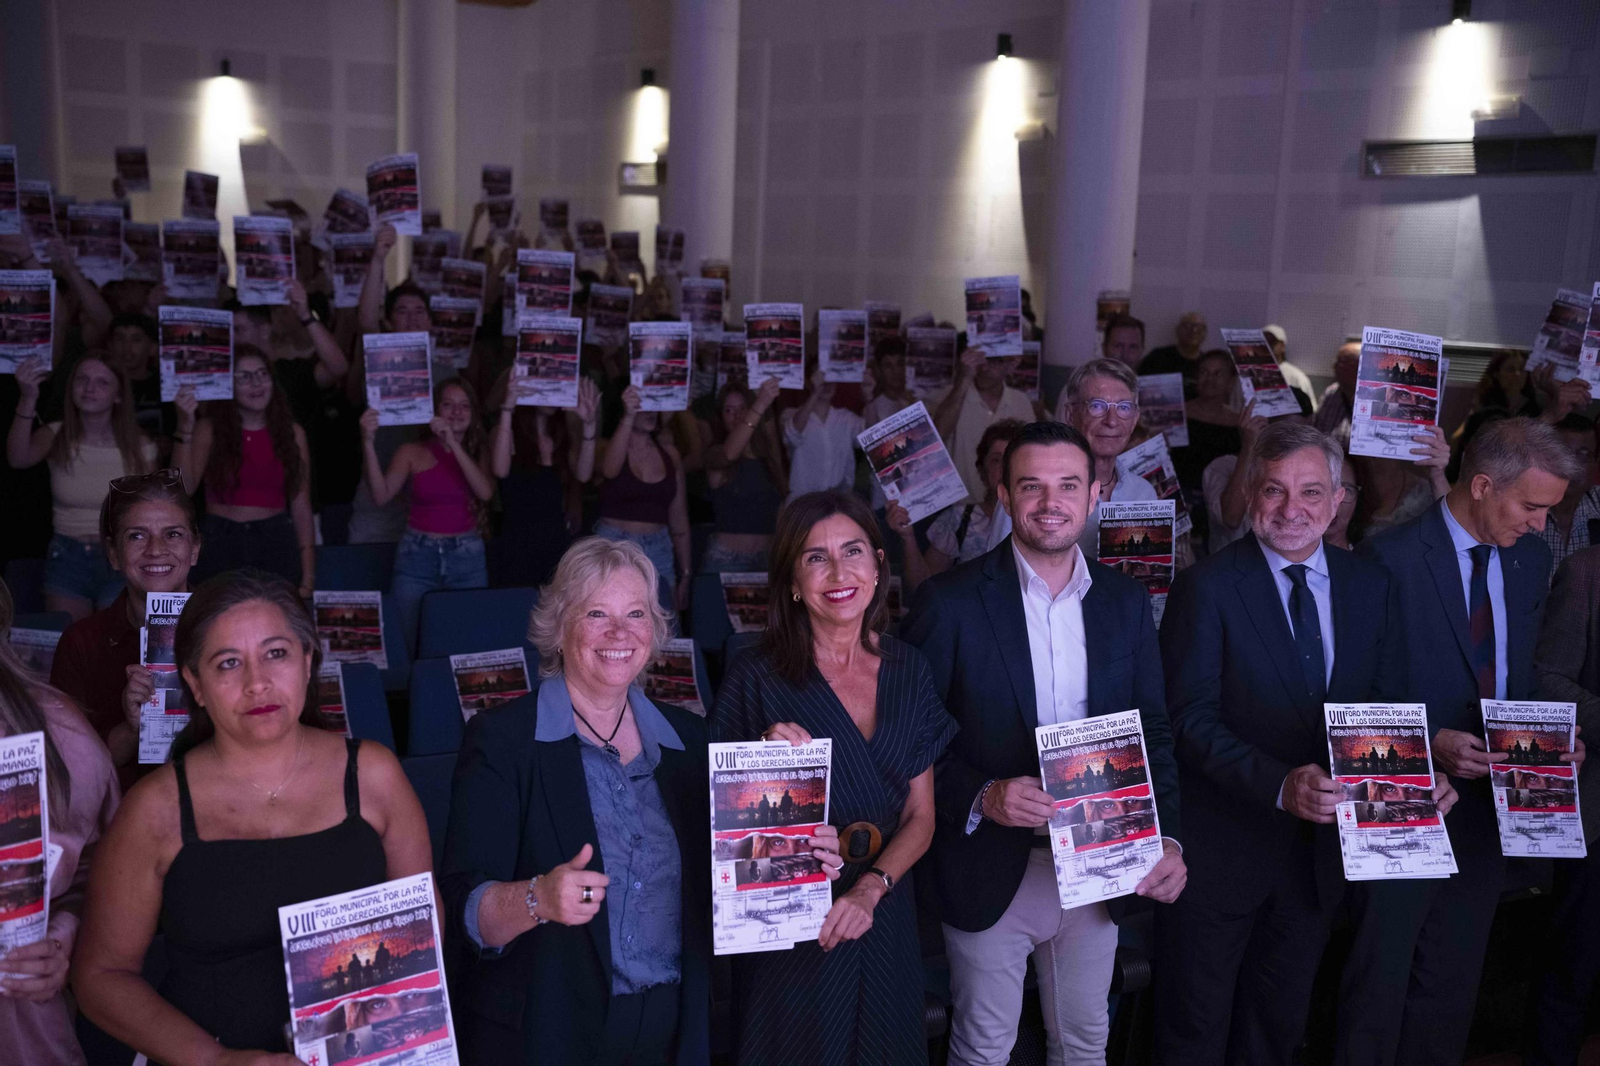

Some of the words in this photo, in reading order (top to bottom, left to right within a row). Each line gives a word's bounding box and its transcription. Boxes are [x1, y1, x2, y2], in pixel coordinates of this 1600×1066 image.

[1366, 332, 1381, 343] VIII
[1394, 335, 1415, 343] MUNICIPAL
[1102, 508, 1115, 518] VIII
[152, 599, 172, 613] VIII
[1329, 711, 1347, 724] VIII
[1486, 706, 1498, 718] VIII
[1041, 732, 1060, 748] VIII
[1060, 729, 1074, 737] FORO
[1076, 723, 1106, 734] MUNICIPAL
[1082, 731, 1111, 741] DERECHOS
[1112, 725, 1138, 736] HUMANOS
[3, 749, 15, 760] LA
[18, 745, 36, 757] PAZ
[715, 752, 736, 769] VIII
[755, 749, 790, 758] MUNICIPAL
[0, 757, 36, 772] MANOS
[762, 759, 795, 767] DERECHOS
[288, 912, 316, 936] VIII
[316, 906, 338, 918] FORO
[340, 896, 382, 913] MUNICIPAL
[384, 891, 399, 901] POR
[401, 888, 411, 897] LA
[413, 883, 427, 894] PAZ
[331, 916, 346, 926] LOS
[348, 904, 389, 922] DERECHOS
[391, 894, 428, 911] HUMANOS
